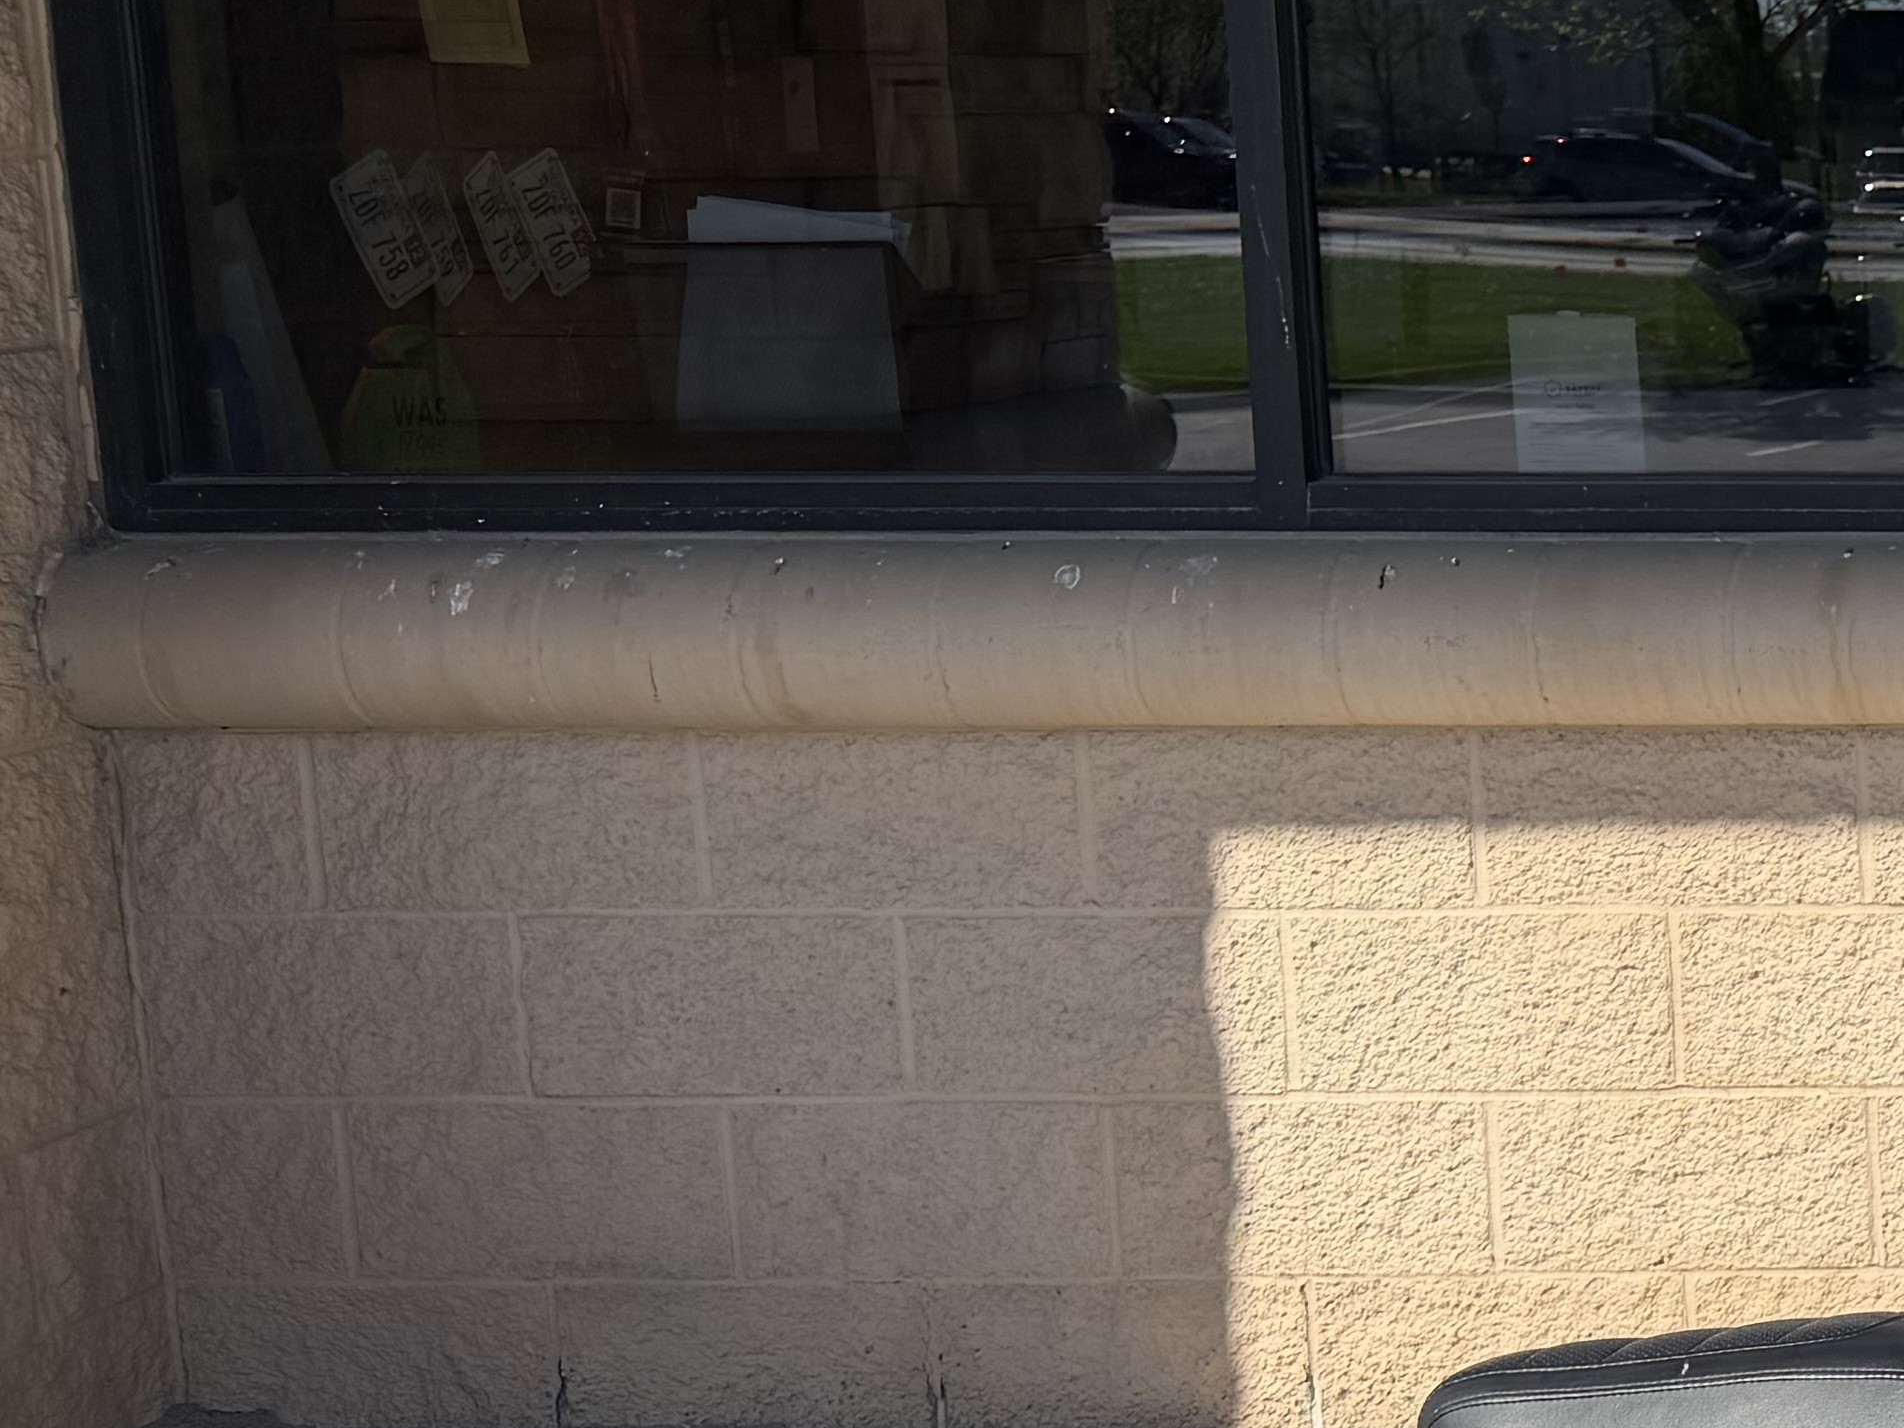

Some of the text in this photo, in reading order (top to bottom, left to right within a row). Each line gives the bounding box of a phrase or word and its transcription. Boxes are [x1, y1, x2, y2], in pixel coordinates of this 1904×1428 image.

[371, 235, 411, 280] 758
[491, 232, 521, 276] 761
[542, 227, 577, 270] 760
[390, 394, 447, 428] WAS
